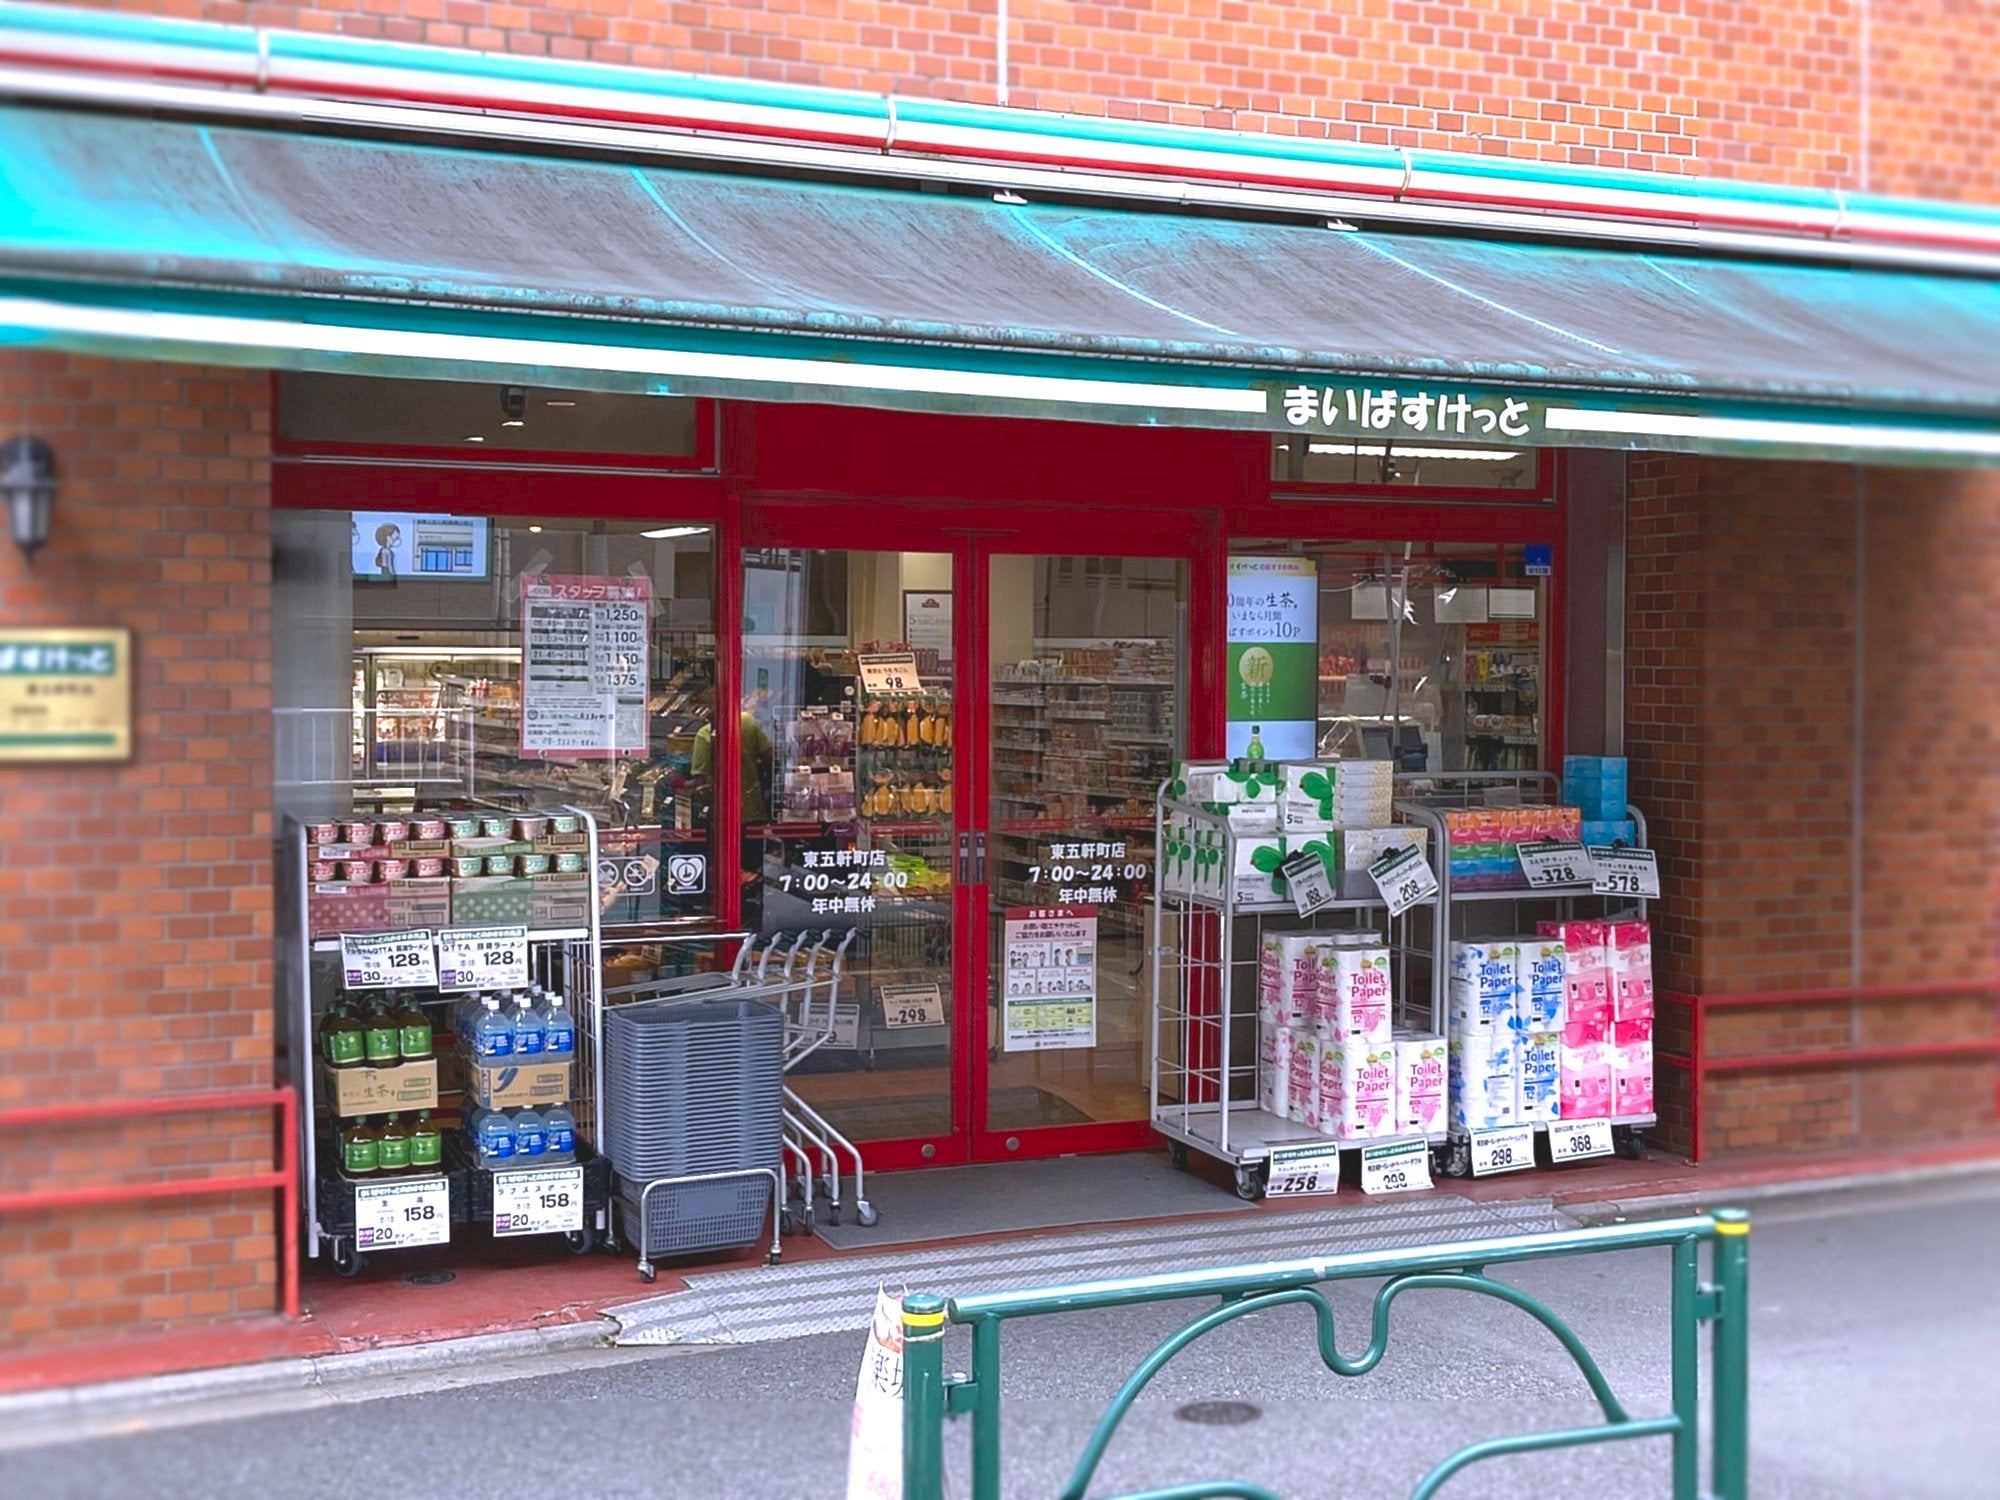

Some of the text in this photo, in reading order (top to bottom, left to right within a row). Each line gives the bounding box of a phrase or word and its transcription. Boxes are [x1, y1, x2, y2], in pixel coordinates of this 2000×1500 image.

[1283, 385, 1530, 436] まいばすけっと
[885, 677, 903, 689] 98
[1286, 814, 1293, 824] 5
[1050, 842, 1126, 860] 東五軒町店
[803, 850, 885, 868] 東五軒町店
[1542, 867, 1576, 882] 328
[1608, 875, 1640, 892] 578
[1059, 886, 1117, 904] 年中無休
[1237, 892, 1243, 902] 5
[1400, 880, 1420, 902] 208
[811, 896, 876, 914] 年中無休
[388, 953, 420, 968] 128
[483, 951, 514, 966] 128
[1480, 963, 1510, 976] Toilet
[1531, 961, 1562, 975] Toilet
[363, 971, 380, 981] 30
[457, 970, 474, 983] 30
[1351, 973, 1385, 986] Toilet
[1480, 976, 1513, 989] Paper
[1532, 974, 1563, 987] Paper
[1352, 985, 1388, 999] Paper
[899, 1008, 926, 1023] 298
[1524, 1050, 1555, 1062] Toilet
[1356, 1067, 1389, 1080] Toilet
[1410, 1063, 1442, 1076] Toilet
[1524, 1062, 1556, 1075] Paper
[1357, 1080, 1390, 1093] Paper
[1410, 1076, 1443, 1089] Paper
[1570, 1135, 1591, 1153] 368
[1491, 1148, 1512, 1166] 298
[1284, 1176, 1318, 1192] 258
[539, 1193, 569, 1208] 158
[403, 1206, 435, 1221] 158
[512, 1214, 528, 1226] 20
[376, 1228, 393, 1240] 20
